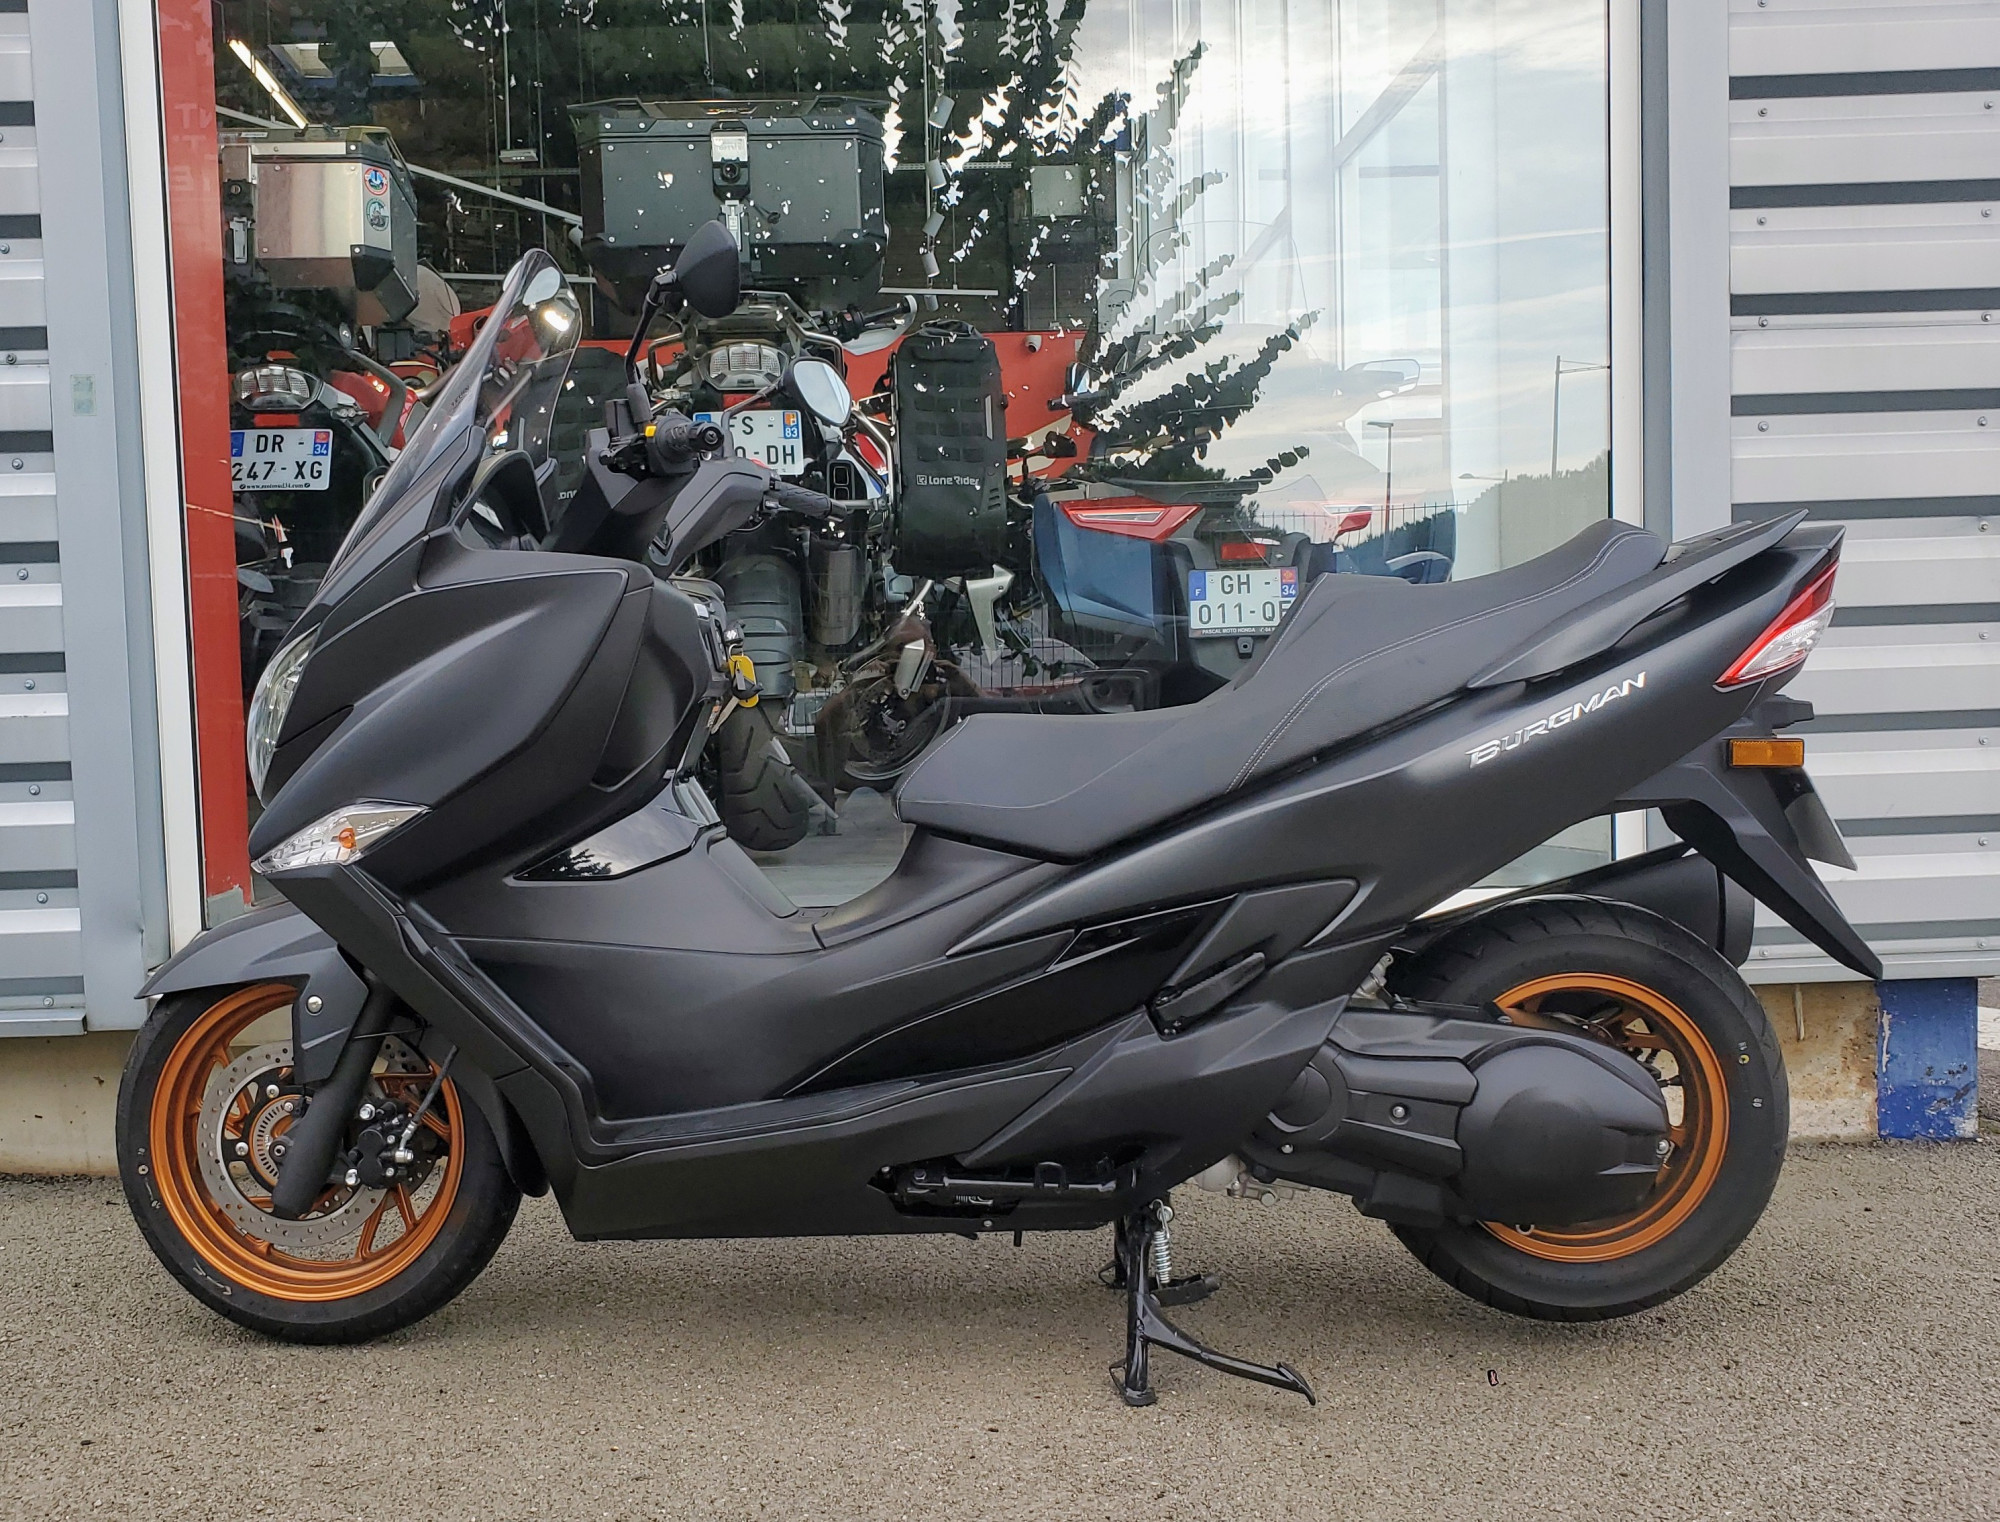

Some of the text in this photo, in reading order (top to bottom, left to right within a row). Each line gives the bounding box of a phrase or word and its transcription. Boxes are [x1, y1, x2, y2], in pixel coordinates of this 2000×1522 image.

[785, 427, 798, 438] 83
[314, 444, 328, 455] 34
[232, 461, 323, 481] 247-XG
[928, 475, 953, 485] Lone
[953, 475, 979, 486] Rider
[1220, 573, 1251, 595] GH
[1195, 588, 1202, 597] F
[1282, 585, 1296, 596] 34
[1465, 671, 1646, 769] BURGMAN
